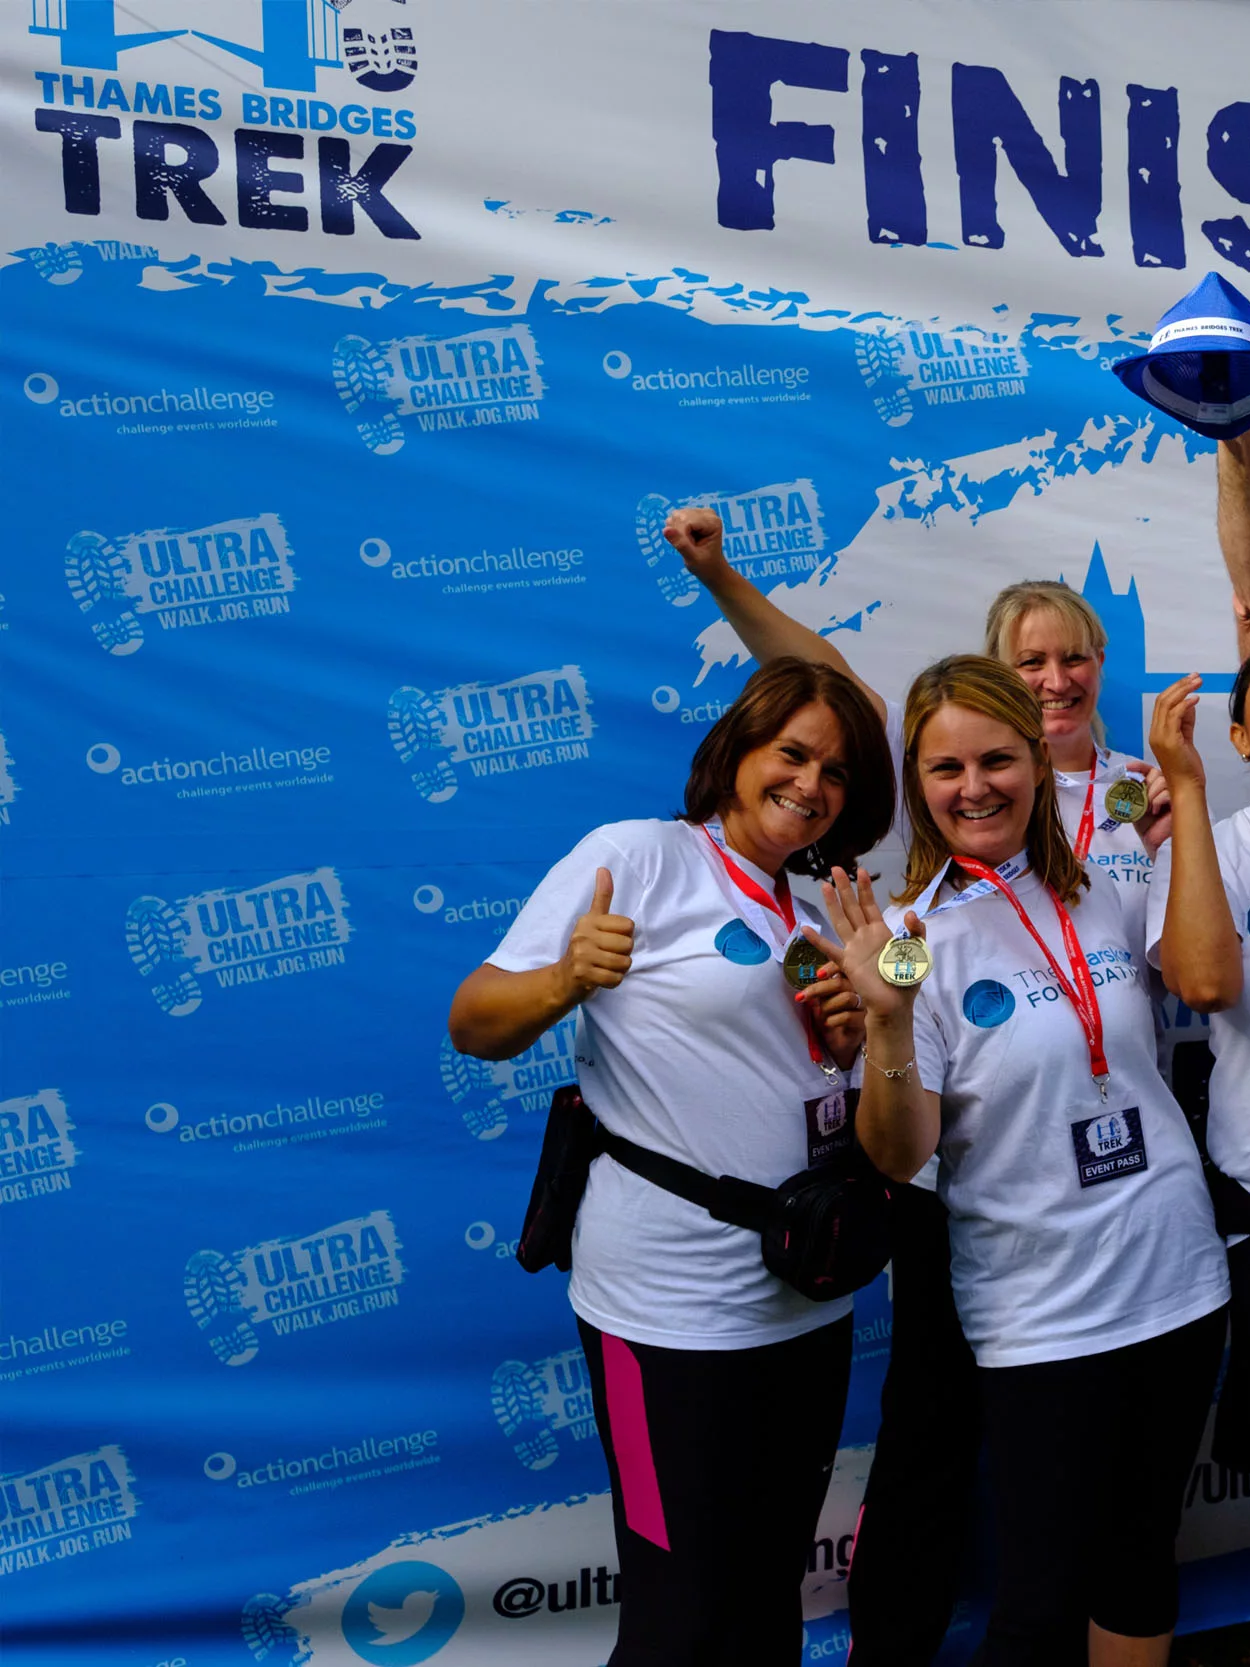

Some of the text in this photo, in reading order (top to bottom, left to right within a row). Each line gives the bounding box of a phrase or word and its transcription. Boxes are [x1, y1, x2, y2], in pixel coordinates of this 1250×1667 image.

[35, 71, 417, 140] THAMES BRIDGES
[35, 108, 422, 240] TREK
[401, 337, 528, 384] ULTRA
[631, 365, 809, 391] actionchallenge
[918, 355, 1021, 384] CHALLENGE
[60, 387, 274, 418] actionchallenge
[408, 375, 534, 411] CHALLENGE
[924, 380, 1026, 406] WALK.JOG.RUN
[116, 418, 278, 435] challenge events worldwide
[417, 403, 540, 433] WALK.JOG.RUN
[709, 491, 811, 535] LTRA
[137, 527, 281, 578] ULTRA
[722, 527, 816, 559] HALLENGE
[391, 546, 584, 579] actionchallenge
[149, 566, 285, 605] CHALLENGE
[441, 574, 587, 596] challenge events worldwide
[157, 595, 290, 631] WALK.JOG.RUN
[453, 676, 578, 731] ULTRA
[463, 714, 586, 755] CHALLENGE
[121, 744, 332, 786] actionchallenge
[470, 741, 589, 778] WALK.JOG.RUN
[176, 773, 335, 800] challenge events worldwide
[198, 881, 336, 938] ULTRA
[207, 917, 341, 965] CHALLENGE
[216, 947, 346, 988] WALK.JOG.RUN
[894, 972, 916, 981] TREK
[179, 1092, 385, 1143] actionchallenge
[232, 1136, 289, 1152] challenge
[328, 1118, 388, 1137] worldwide
[1097, 1139, 1123, 1151] TREK
[1085, 1154, 1140, 1178] EVENT PASS
[253, 1224, 391, 1288] ULTRA
[263, 1260, 394, 1313] CHALLENGE
[272, 1288, 399, 1336] WALK.JOG.RUN
[67, 1346, 131, 1368] worldwide
[236, 1430, 438, 1488] actionchallenge
